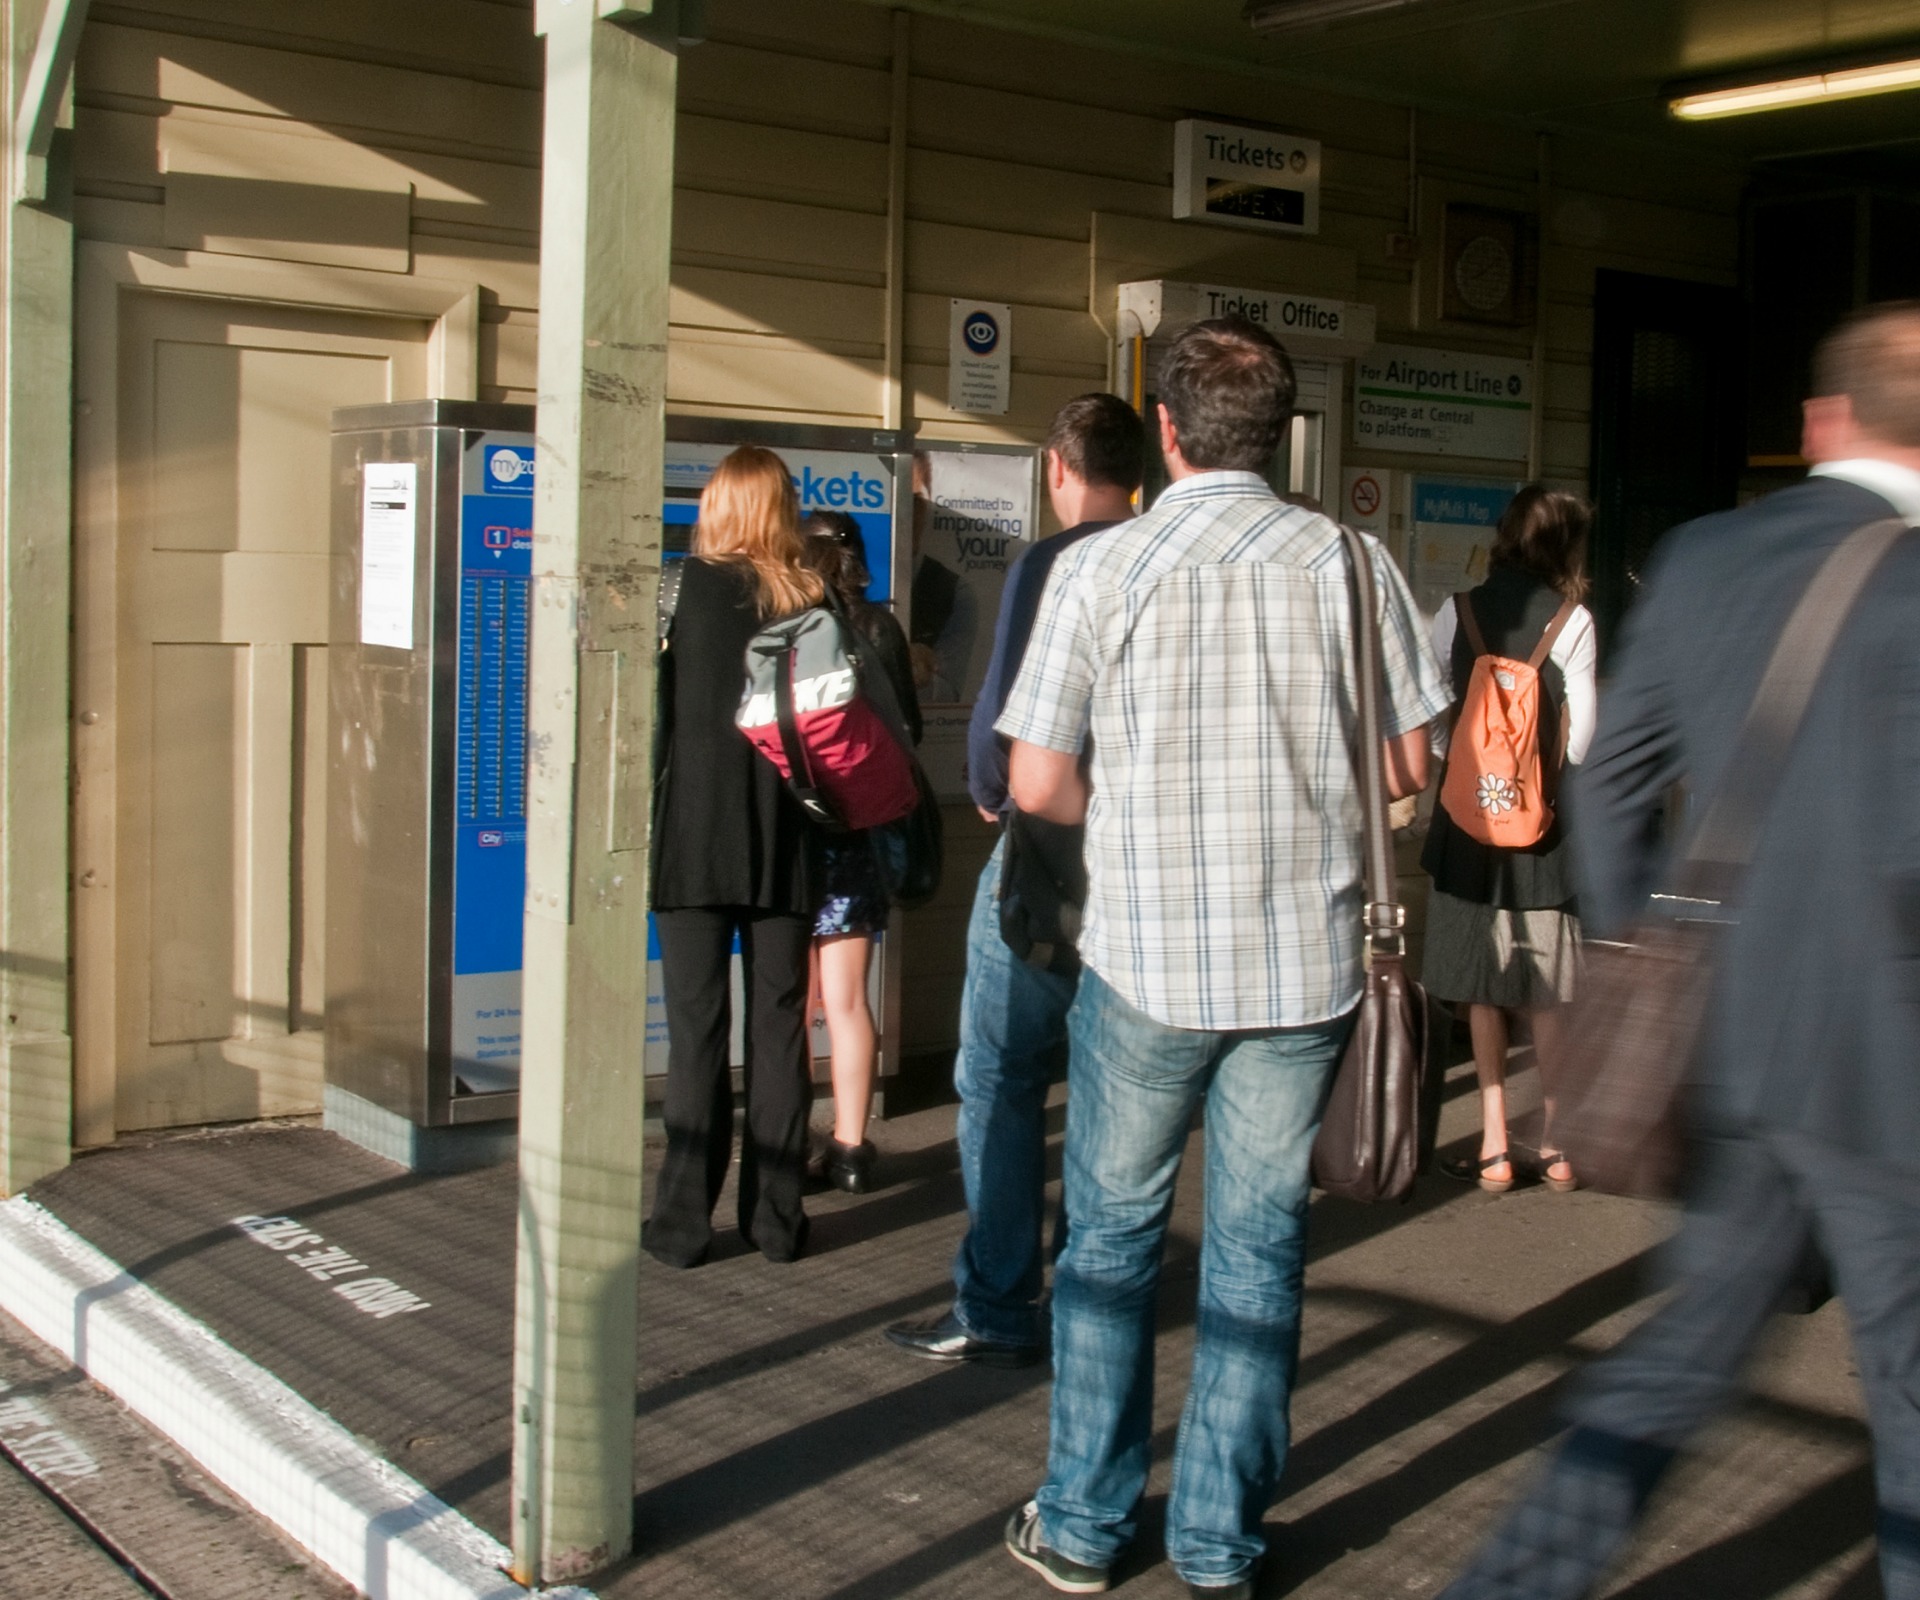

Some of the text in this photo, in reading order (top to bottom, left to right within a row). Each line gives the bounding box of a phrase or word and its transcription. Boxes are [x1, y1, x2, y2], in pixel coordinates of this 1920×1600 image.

[1205, 134, 1285, 171] Tickets
[1207, 291, 1340, 331] Ticket Office
[1360, 360, 1504, 396] For Airport Line
[1359, 400, 1474, 425] Change at Central
[1358, 420, 1373, 433] to
[1376, 421, 1432, 442] platform
[492, 458, 535, 479] myzo
[935, 495, 1014, 511] Committed to
[493, 530, 502, 545] 1
[933, 512, 1022, 539] improving
[956, 536, 1009, 563] your
[965, 558, 1008, 573] journey
[230, 1215, 432, 1319] MIND THE STEP
